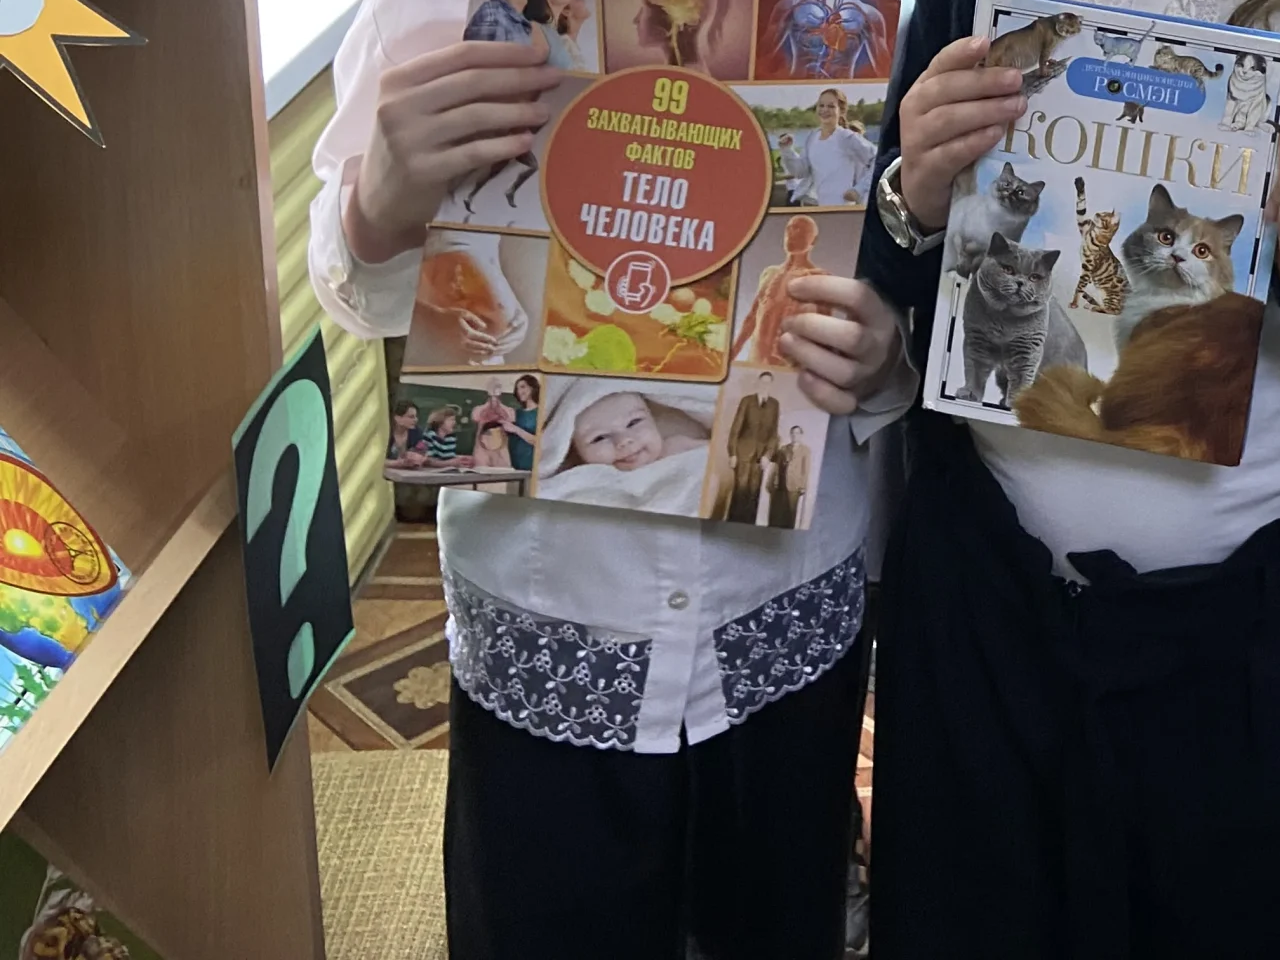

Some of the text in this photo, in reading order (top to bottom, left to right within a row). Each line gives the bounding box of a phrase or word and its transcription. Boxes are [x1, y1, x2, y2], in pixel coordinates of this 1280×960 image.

[652, 77, 690, 115] 99
[587, 107, 743, 150] ЗАХВАТЫВАЮЩИХ
[625, 142, 696, 170] ФАКТОВ
[997, 110, 1258, 196] КОШКИ
[622, 170, 689, 209] ТЕЛО
[580, 203, 715, 251] ЧЕЛОВЕКА
